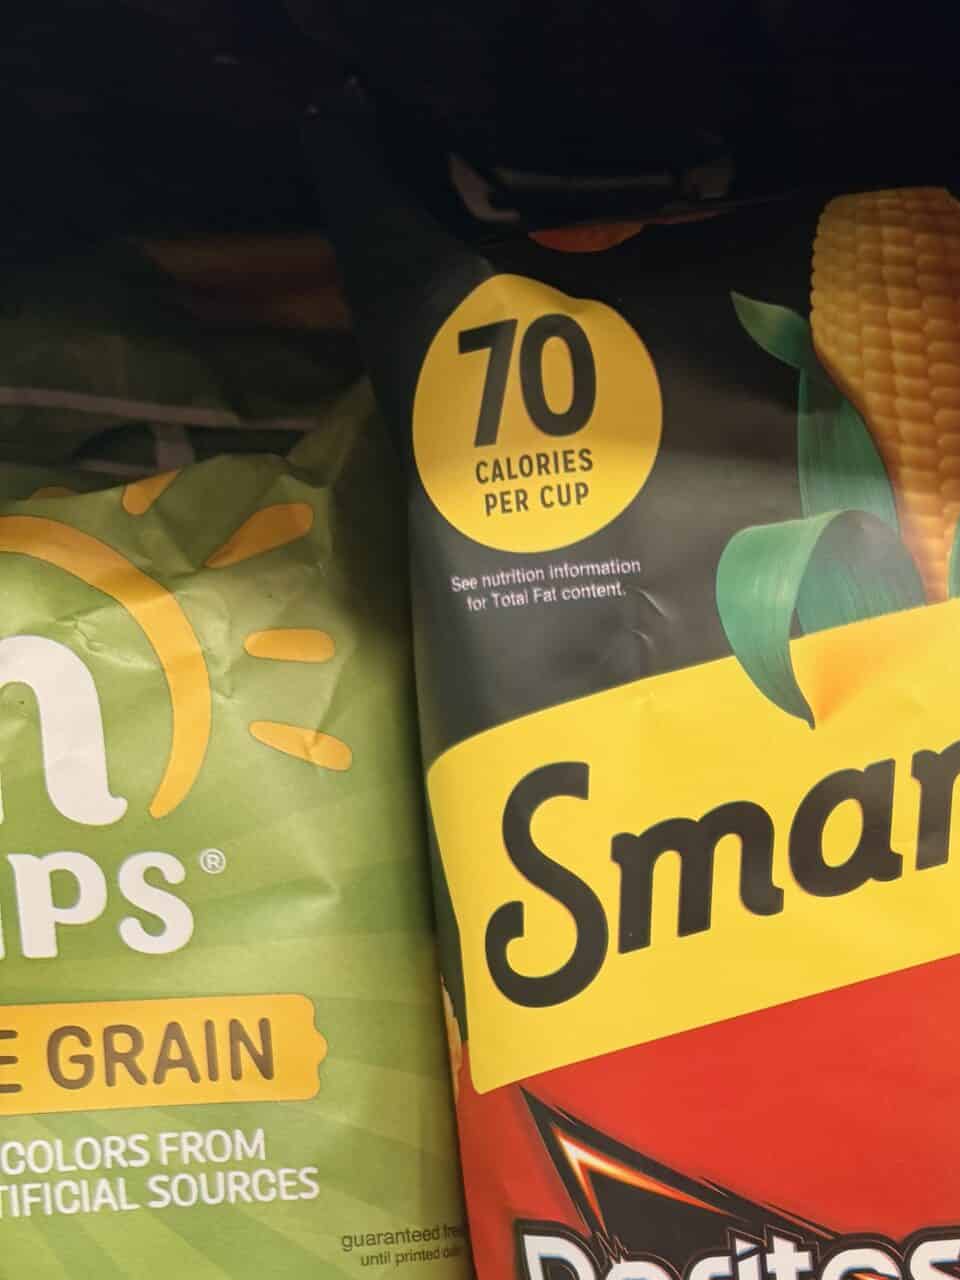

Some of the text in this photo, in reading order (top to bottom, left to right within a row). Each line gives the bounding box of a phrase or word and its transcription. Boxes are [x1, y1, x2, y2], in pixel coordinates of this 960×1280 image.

[458, 313, 596, 448] 70
[474, 448, 593, 485] CALORIES
[484, 483, 590, 516] PER CUP
[451, 576, 478, 592] See
[482, 568, 545, 589] nutrition
[466, 581, 626, 612] for Total Fat content.
[47, 1018, 274, 1090] GRAIN
[0, 1128, 266, 1175] COLORS FROM
[147, 1167, 320, 1209] SOURCES
[342, 1224, 440, 1251] guaranteed
[360, 1251, 391, 1267] until
[395, 1247, 440, 1267] printed
